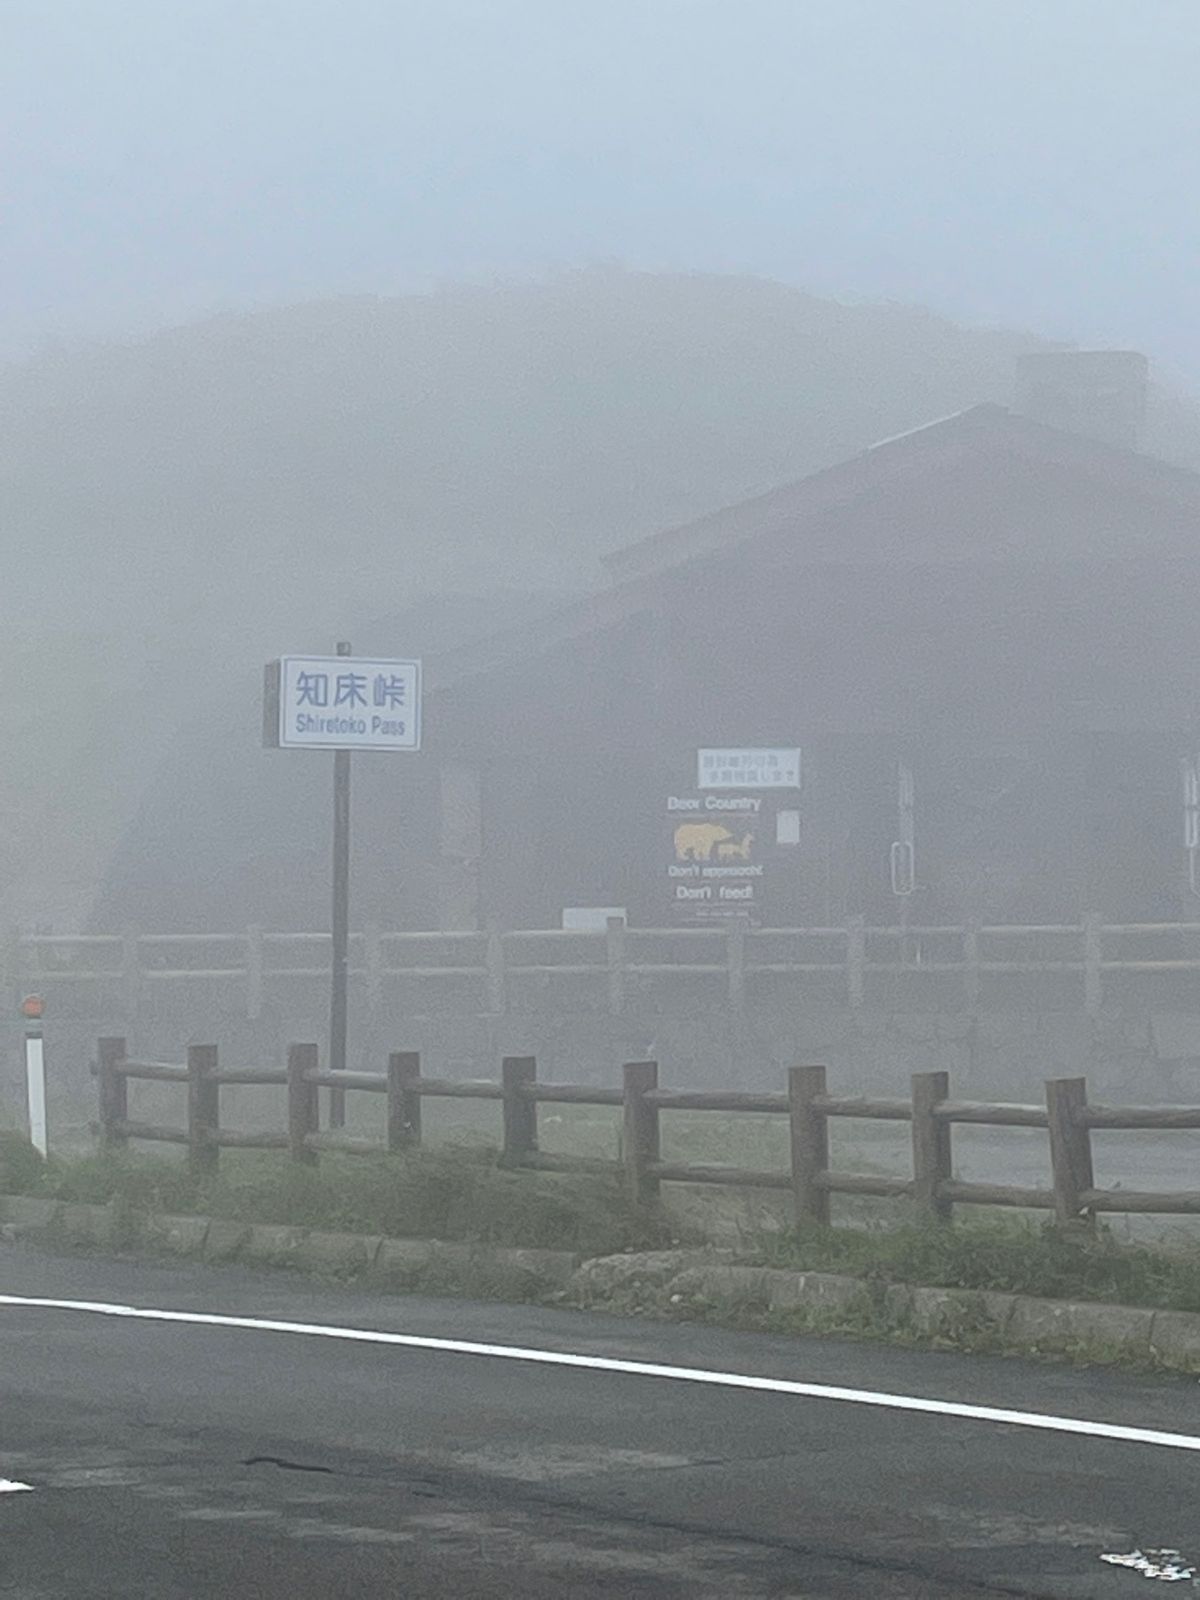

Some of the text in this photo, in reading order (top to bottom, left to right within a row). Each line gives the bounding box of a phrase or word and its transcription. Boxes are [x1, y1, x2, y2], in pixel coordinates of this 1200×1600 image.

[296, 671, 406, 710] 知床峠
[296, 713, 405, 736] Shiretoko Pass
[705, 796, 761, 812] Country
[668, 864, 700, 877] Don't
[676, 885, 711, 899] Don't
